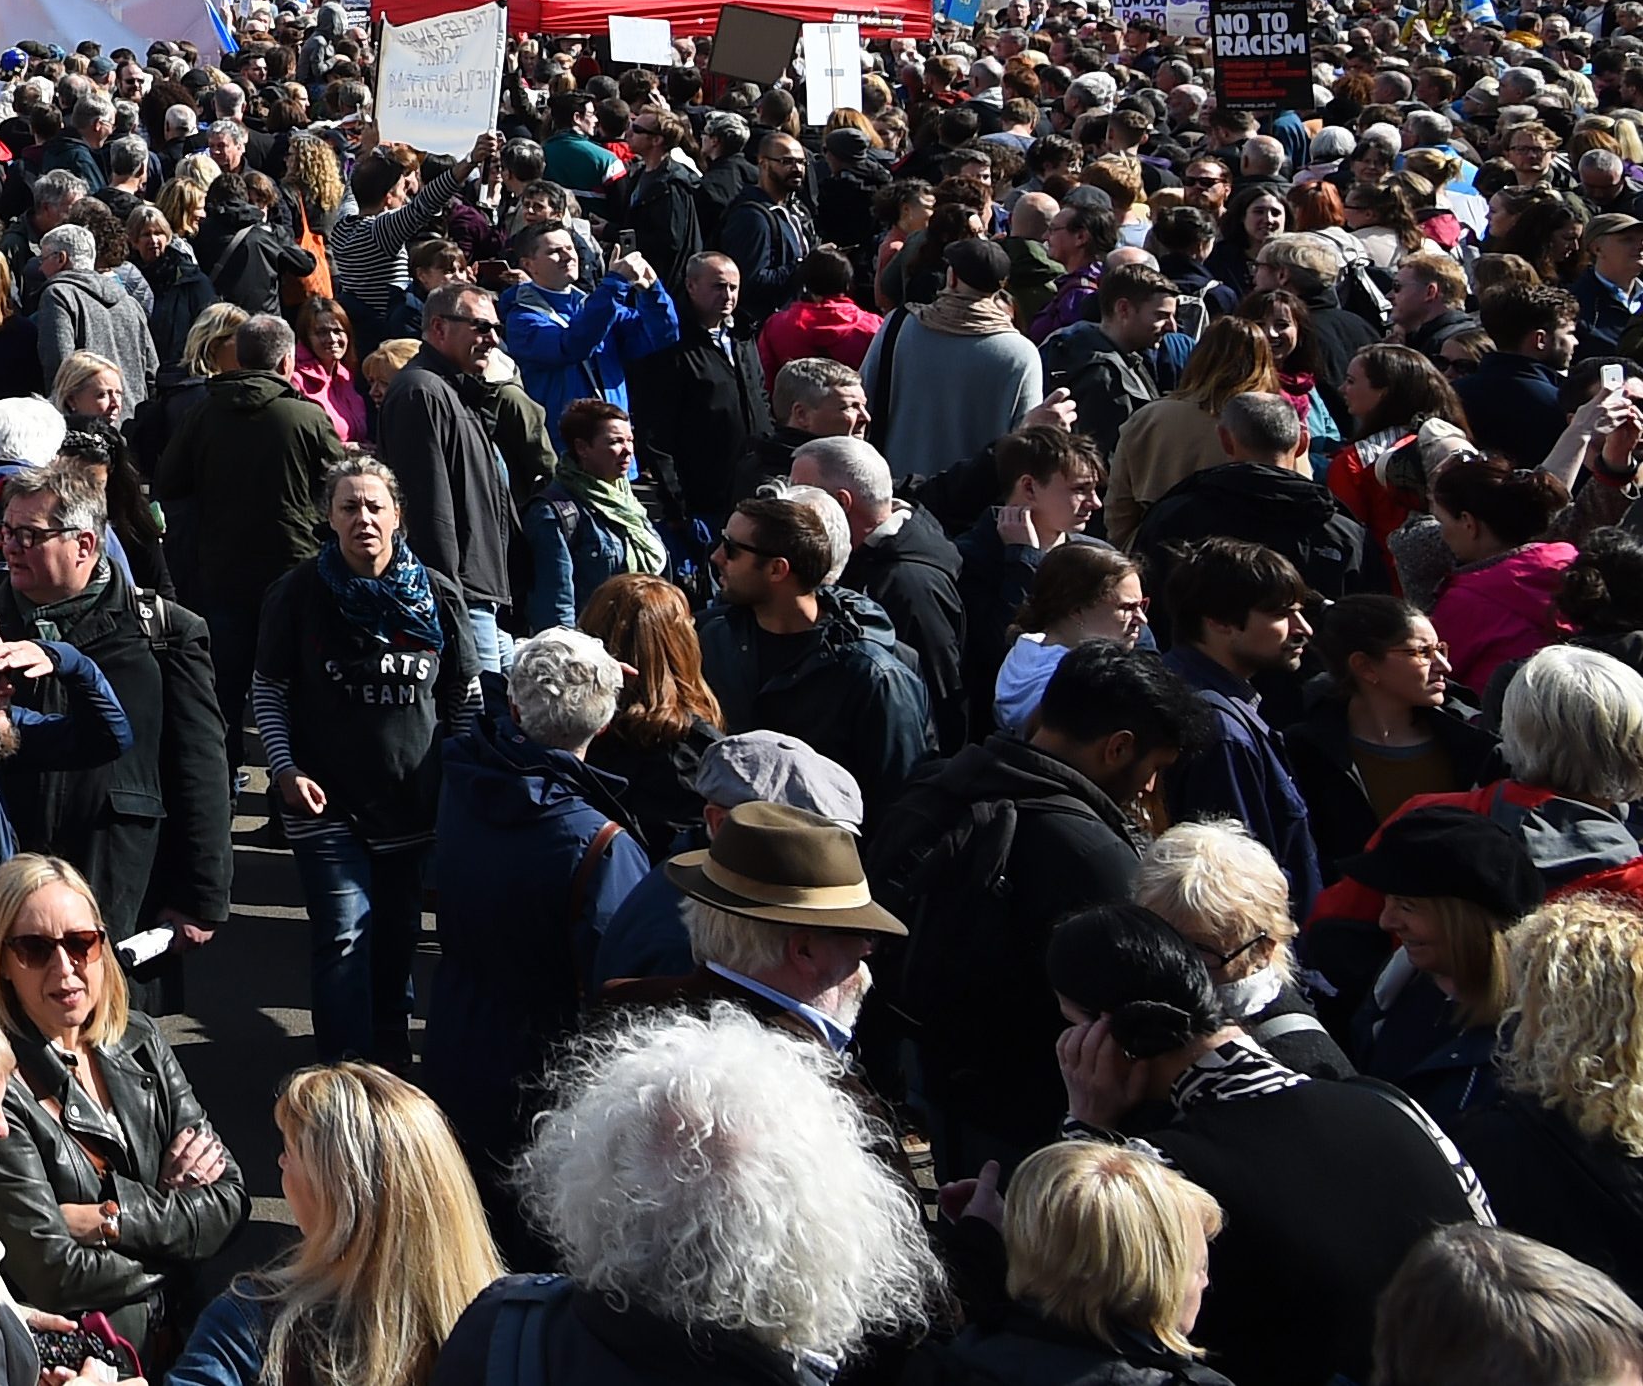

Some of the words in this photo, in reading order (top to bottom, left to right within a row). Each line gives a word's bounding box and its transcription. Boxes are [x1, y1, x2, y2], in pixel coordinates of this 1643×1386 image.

[1215, 13, 1250, 35] NO
[1257, 11, 1289, 34] TO
[1216, 32, 1306, 57] RACISM
[325, 653, 431, 681] SRTS
[344, 684, 416, 705] TEAM
